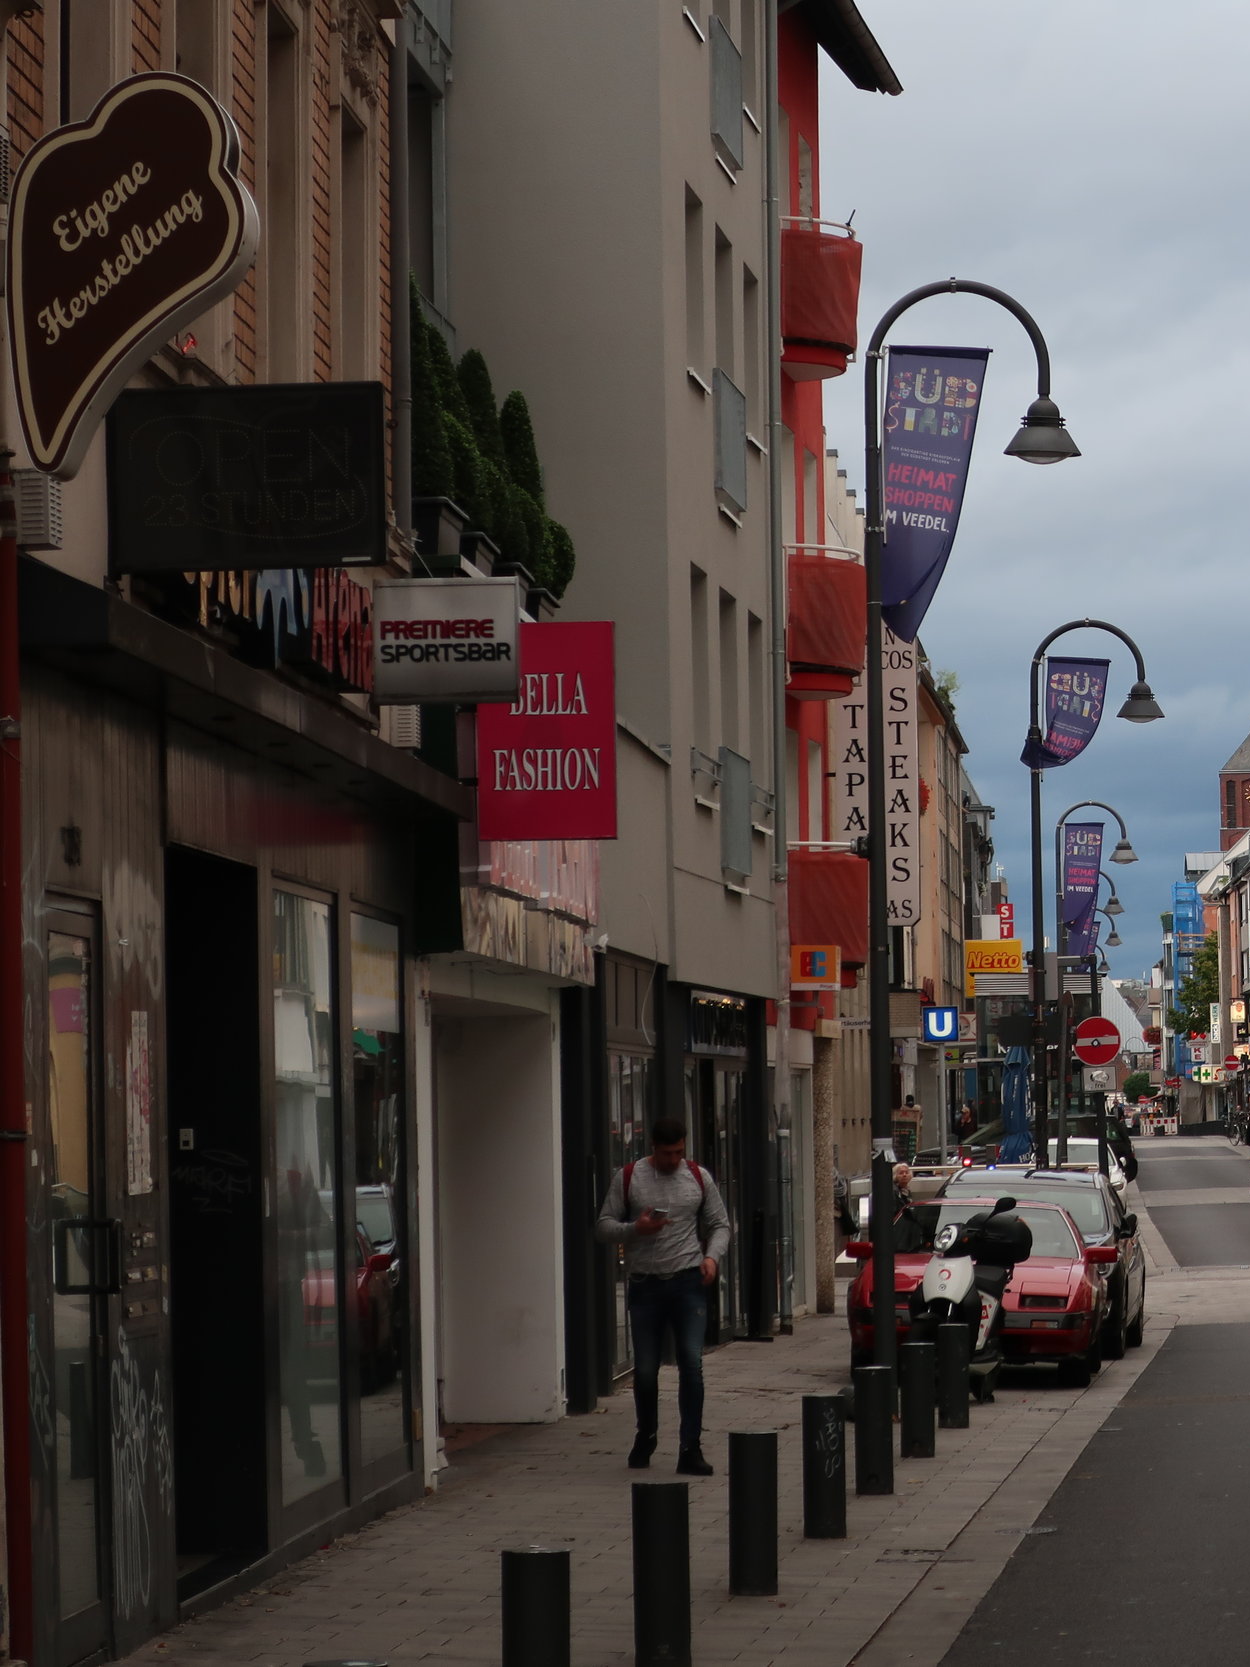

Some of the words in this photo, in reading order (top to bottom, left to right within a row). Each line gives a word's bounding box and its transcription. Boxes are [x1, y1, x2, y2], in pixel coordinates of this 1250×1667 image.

[52, 161, 151, 252] Eigene
[37, 188, 203, 345] Herstellung
[889, 368, 977, 408] SÜD
[885, 401, 975, 440] STADT
[156, 428, 349, 487] OPEN
[887, 462, 957, 493] HEIMAT
[201, 489, 355, 524] STUNDEN
[884, 486, 955, 513] SHOPPEN
[902, 511, 950, 533] VEEDEL.
[379, 619, 494, 640] PREMIERE
[492, 748, 601, 791] FASHION
[888, 687, 911, 882] STEAKS
[966, 951, 1020, 970] Netto
[928, 1012, 953, 1037] U
